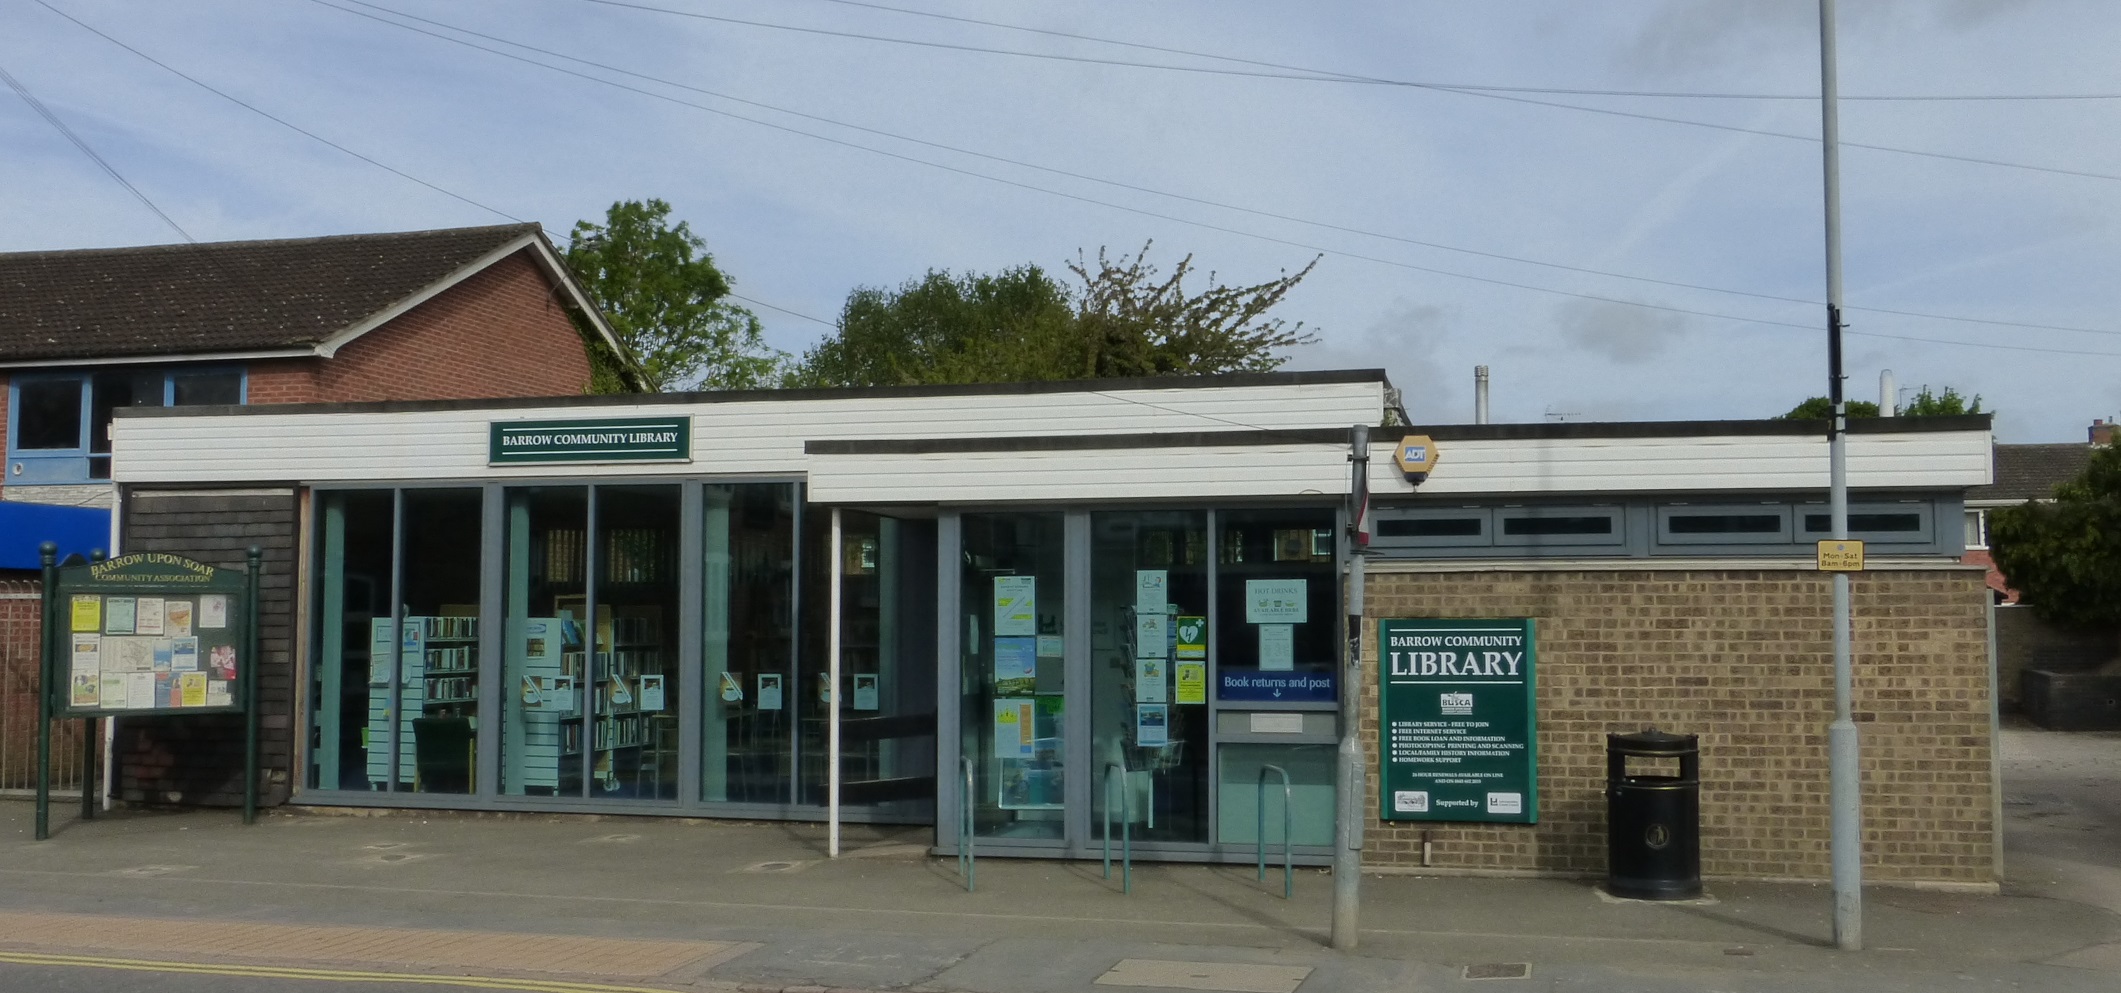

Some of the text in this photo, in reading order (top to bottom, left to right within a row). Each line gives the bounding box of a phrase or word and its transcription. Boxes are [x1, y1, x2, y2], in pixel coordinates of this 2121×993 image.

[502, 432, 678, 446] BARROW COMMUNITY LIBRARY
[1405, 450, 1426, 460] ADT
[90, 553, 214, 577] BARROW UPON SOAR
[95, 574, 211, 582] COMMUNITY ASSOCIATION
[1390, 636, 1522, 646] BARROW COMMUNITY
[1390, 652, 1522, 676] LIBRARY
[1224, 676, 1330, 690] Book returns and post
[1436, 799, 1469, 807] Supported
